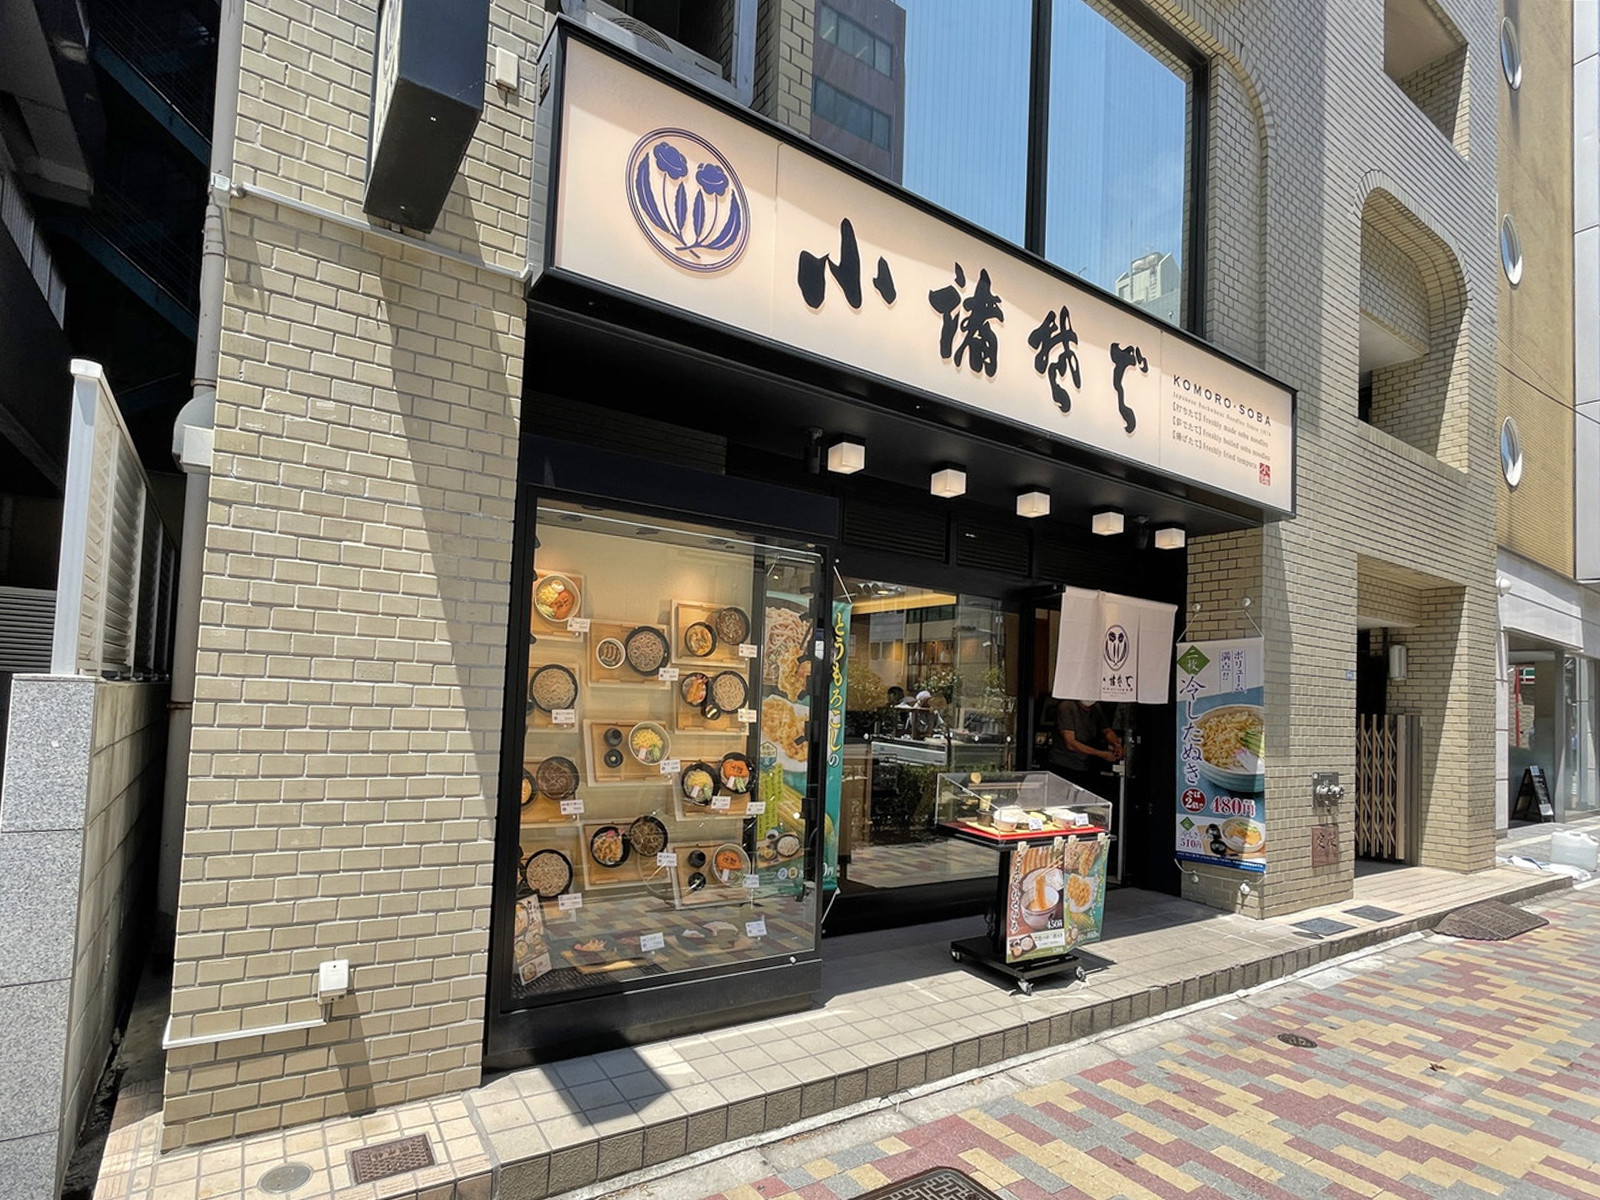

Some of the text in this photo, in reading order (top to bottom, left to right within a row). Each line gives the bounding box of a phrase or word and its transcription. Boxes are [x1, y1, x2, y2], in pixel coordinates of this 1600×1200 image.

[1203, 415, 1222, 431] Freshly
[1223, 425, 1237, 435] made
[1202, 428, 1222, 443] Freshly
[1223, 437, 1239, 450] boiled
[1202, 442, 1222, 458] Freshly
[1223, 450, 1236, 461] fried
[1237, 456, 1257, 469] tempura
[1234, 650, 1244, 691] ボリューム
[828, 612, 845, 768] とうもろこしの
[1179, 676, 1207, 784] 冷したぬき
[1212, 796, 1256, 817] 480円
